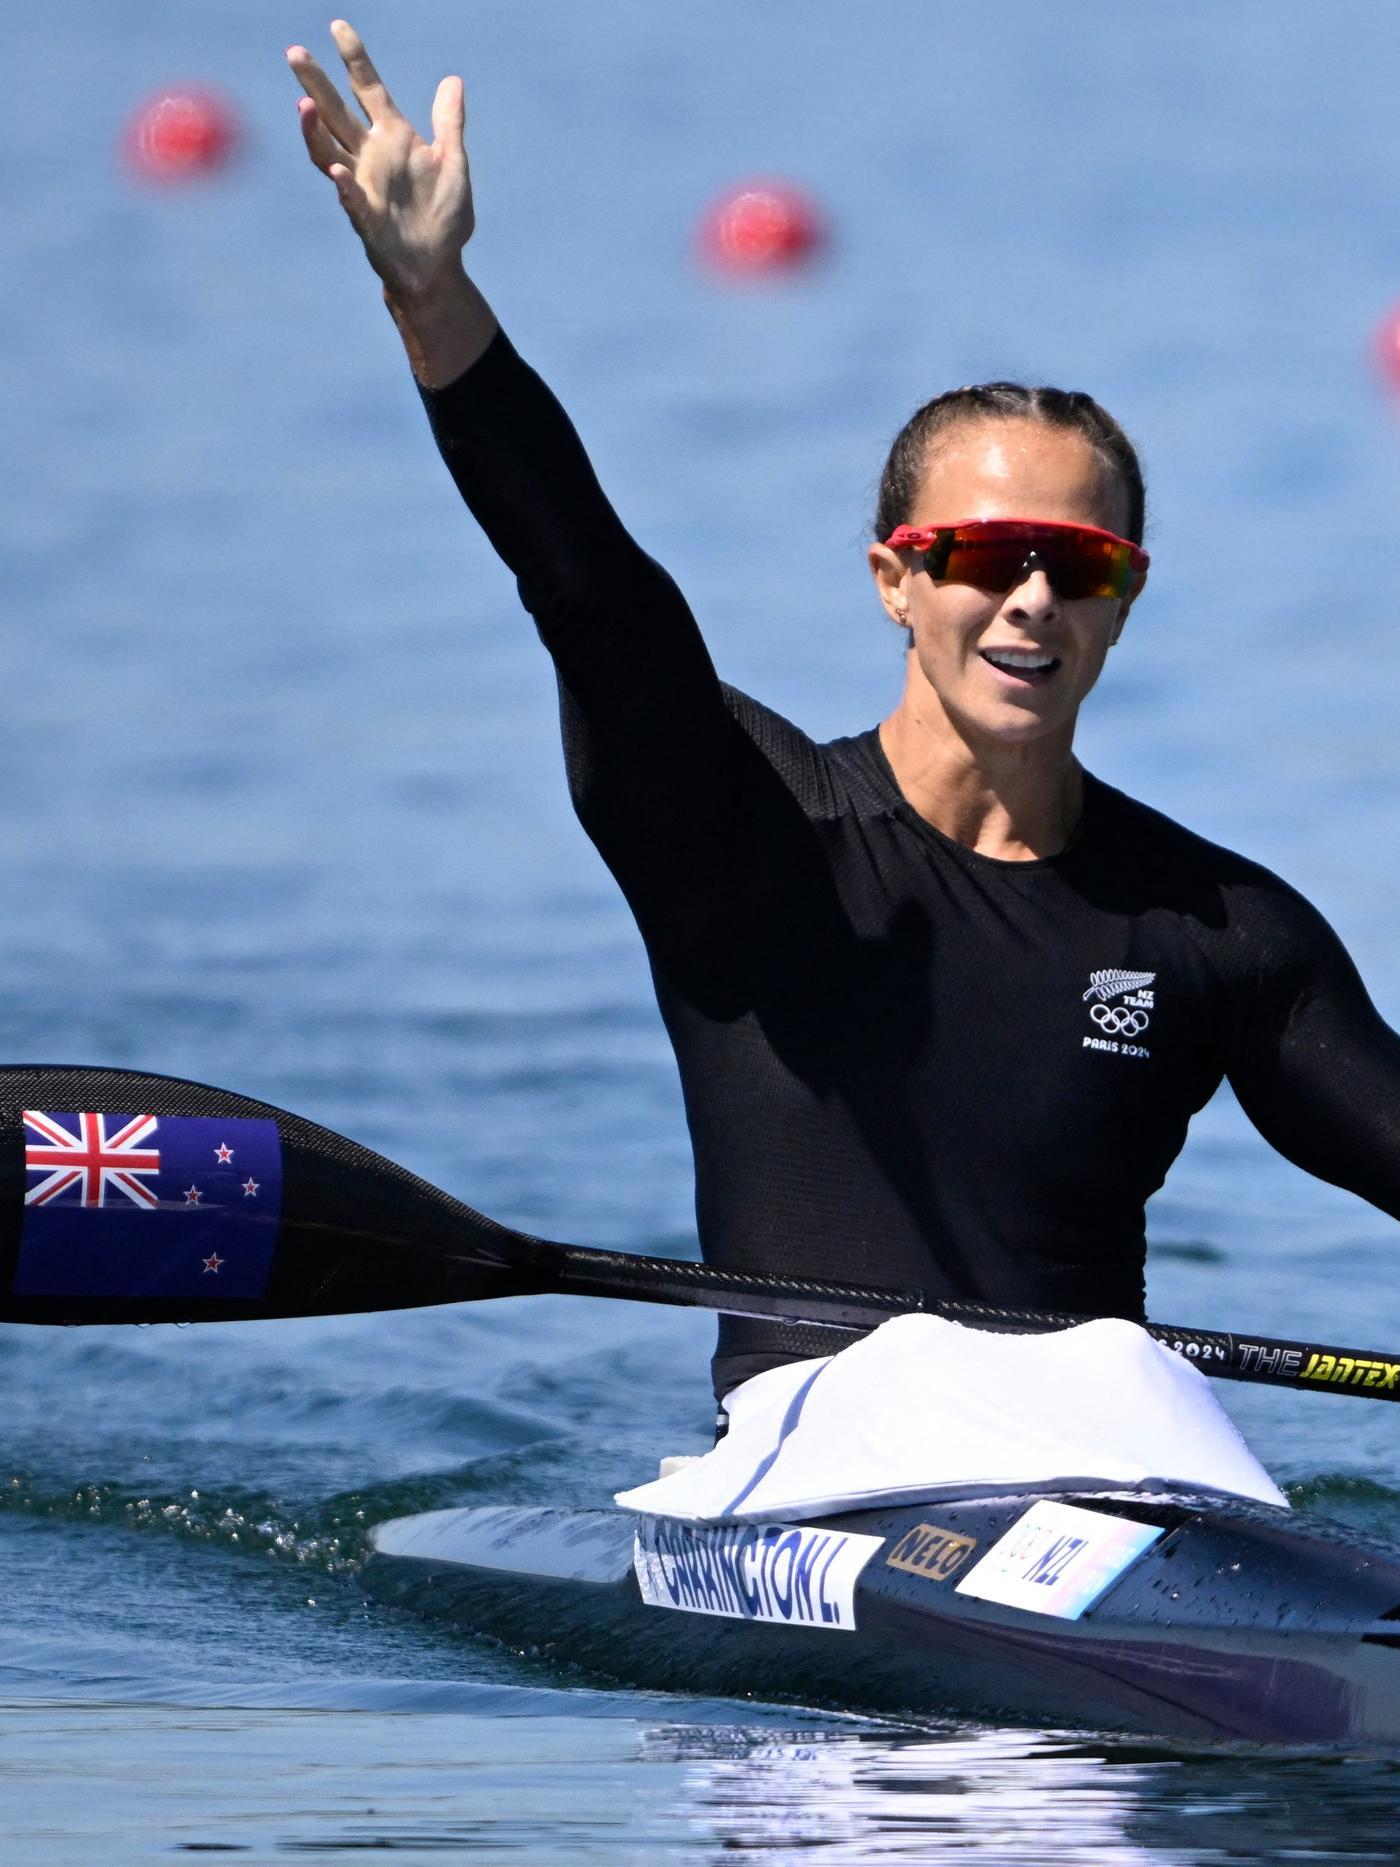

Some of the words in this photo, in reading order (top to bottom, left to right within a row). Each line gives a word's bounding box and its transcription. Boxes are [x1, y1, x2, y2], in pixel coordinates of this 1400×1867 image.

[1123, 995, 1154, 1009] TEAM
[1138, 990, 1155, 1000] NZ
[1083, 1036, 1119, 1052] PARIS
[1121, 1043, 1150, 1058] 2024
[1173, 1341, 1224, 1360] 2024
[1239, 1344, 1302, 1376] THE
[892, 1529, 970, 1576] NELO
[1021, 1535, 1090, 1586] NZL
